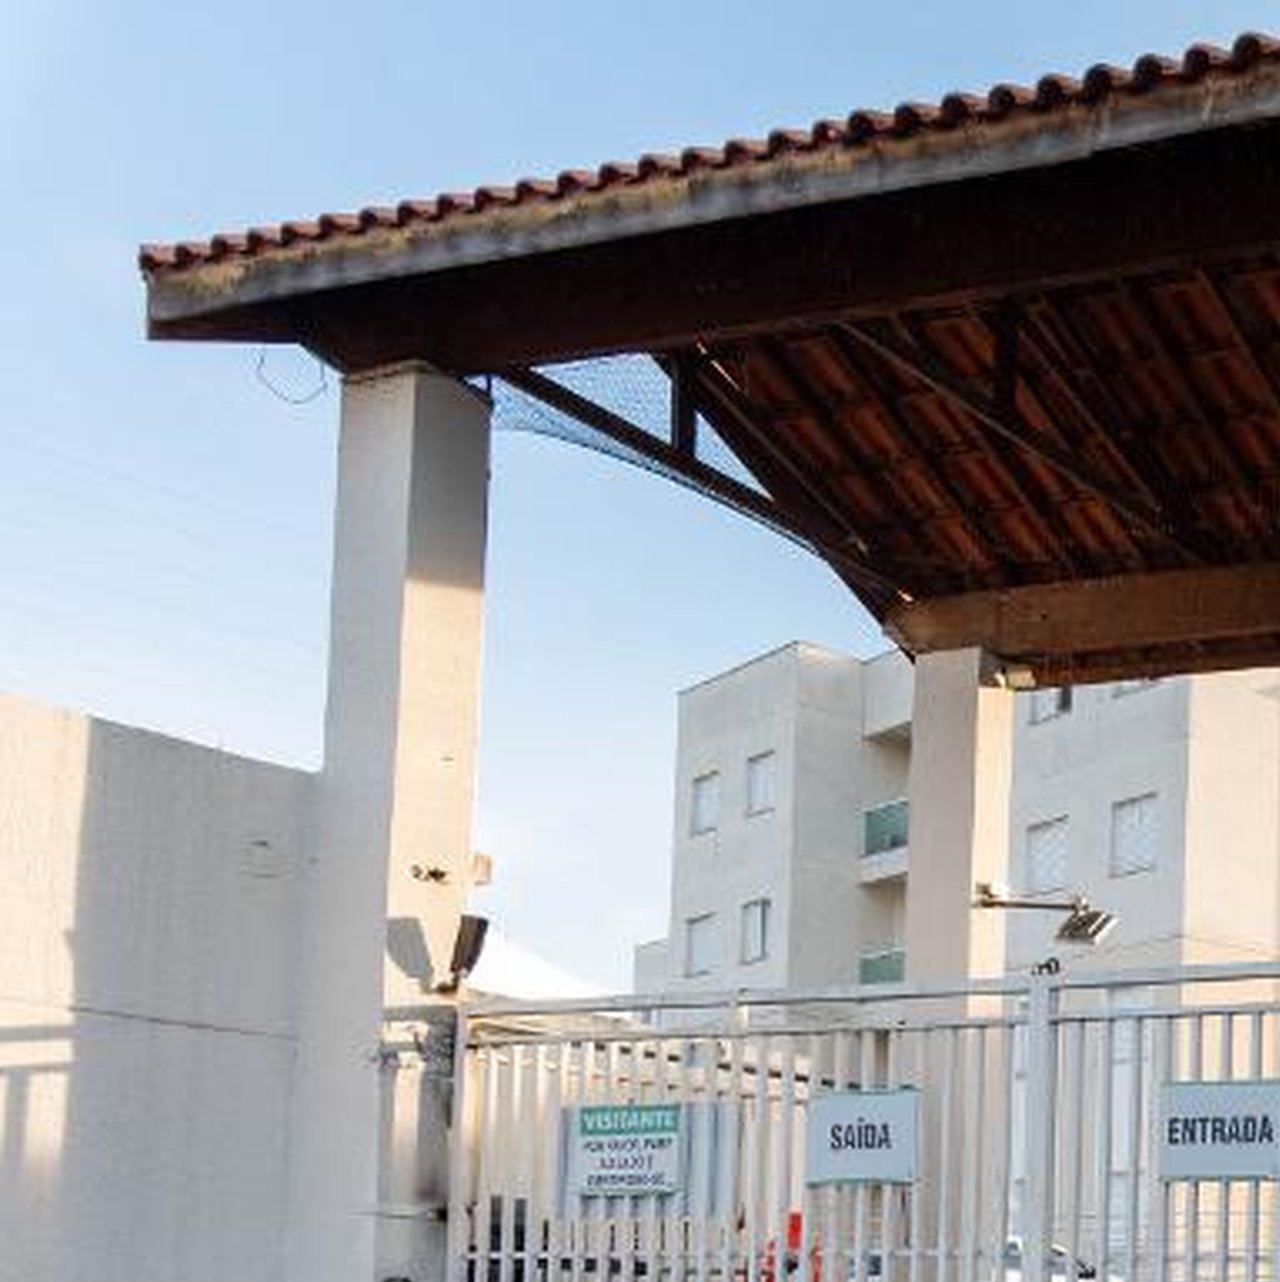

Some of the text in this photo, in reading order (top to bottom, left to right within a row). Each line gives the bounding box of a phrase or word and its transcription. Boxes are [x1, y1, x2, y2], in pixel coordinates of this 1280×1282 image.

[582, 1109, 674, 1131] VISITANTE
[830, 1116, 893, 1150] SAÍDA
[1167, 1116, 1274, 1146] ENTRADA
